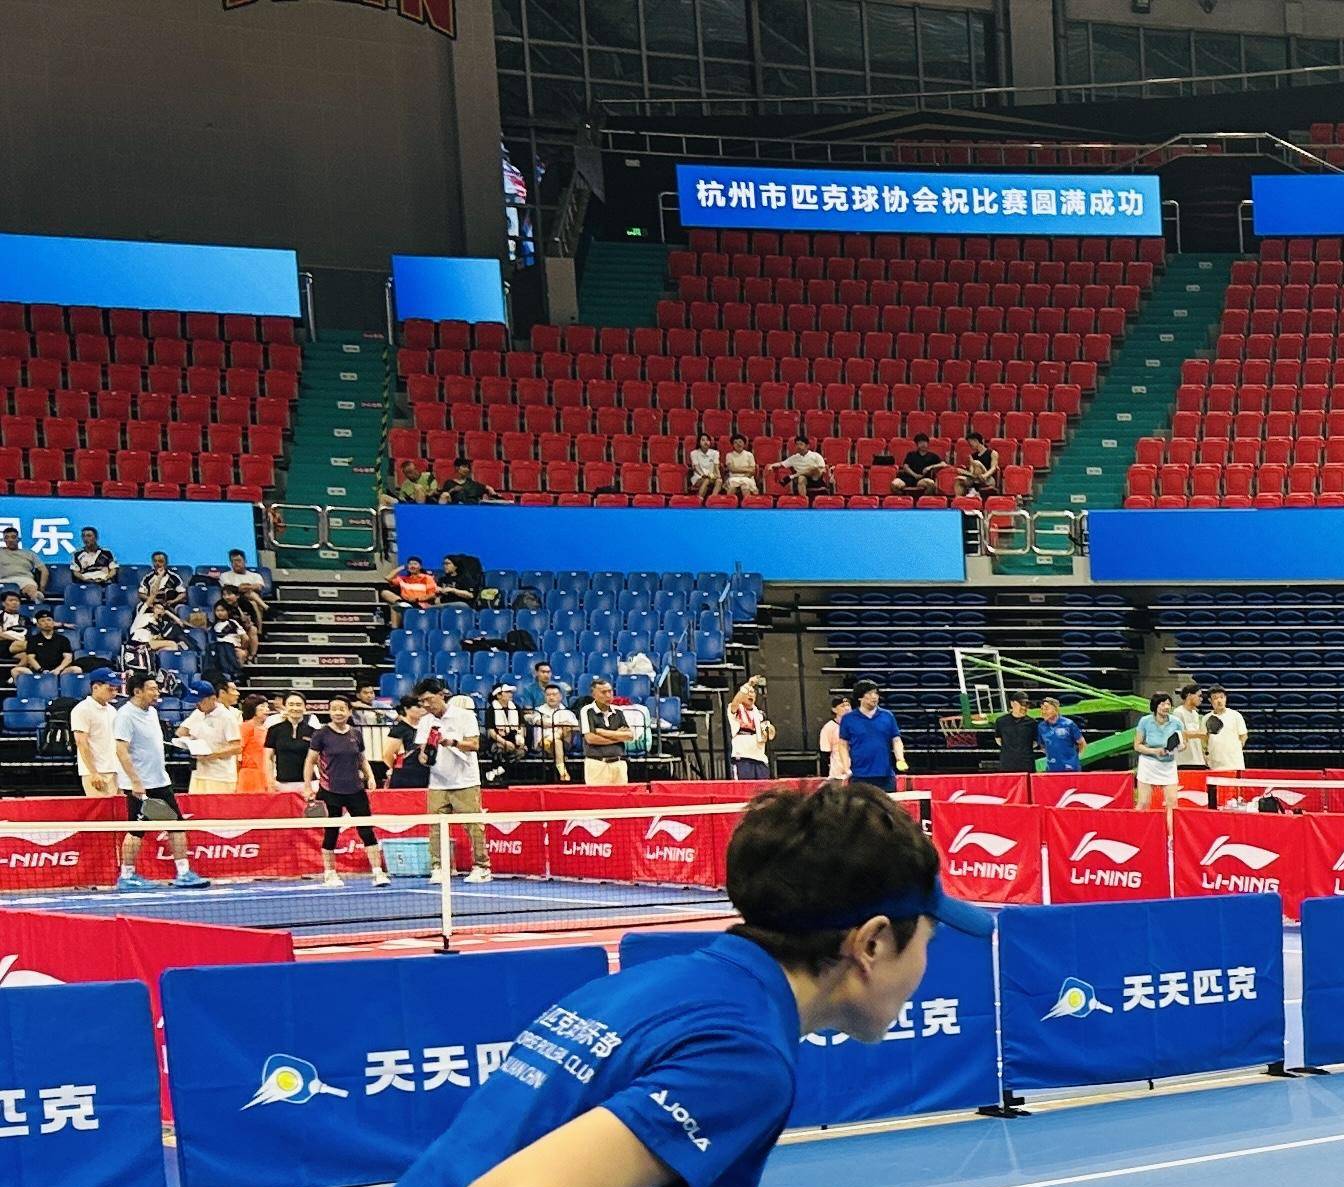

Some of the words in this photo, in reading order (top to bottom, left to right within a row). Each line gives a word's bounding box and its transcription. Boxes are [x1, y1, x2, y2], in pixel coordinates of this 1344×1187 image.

[696, 179, 1144, 217] 杭州市匹克球协会祝比赛圆满成功
[156, 843, 260, 861] L-NING
[563, 840, 612, 858] LI-NING
[646, 844, 695, 863] LI-NING
[950, 859, 1018, 881] LI-NING
[1070, 867, 1142, 889] LI-NING
[1200, 872, 1280, 894] LI-NING
[1122, 966, 1258, 1012] 天天匹克
